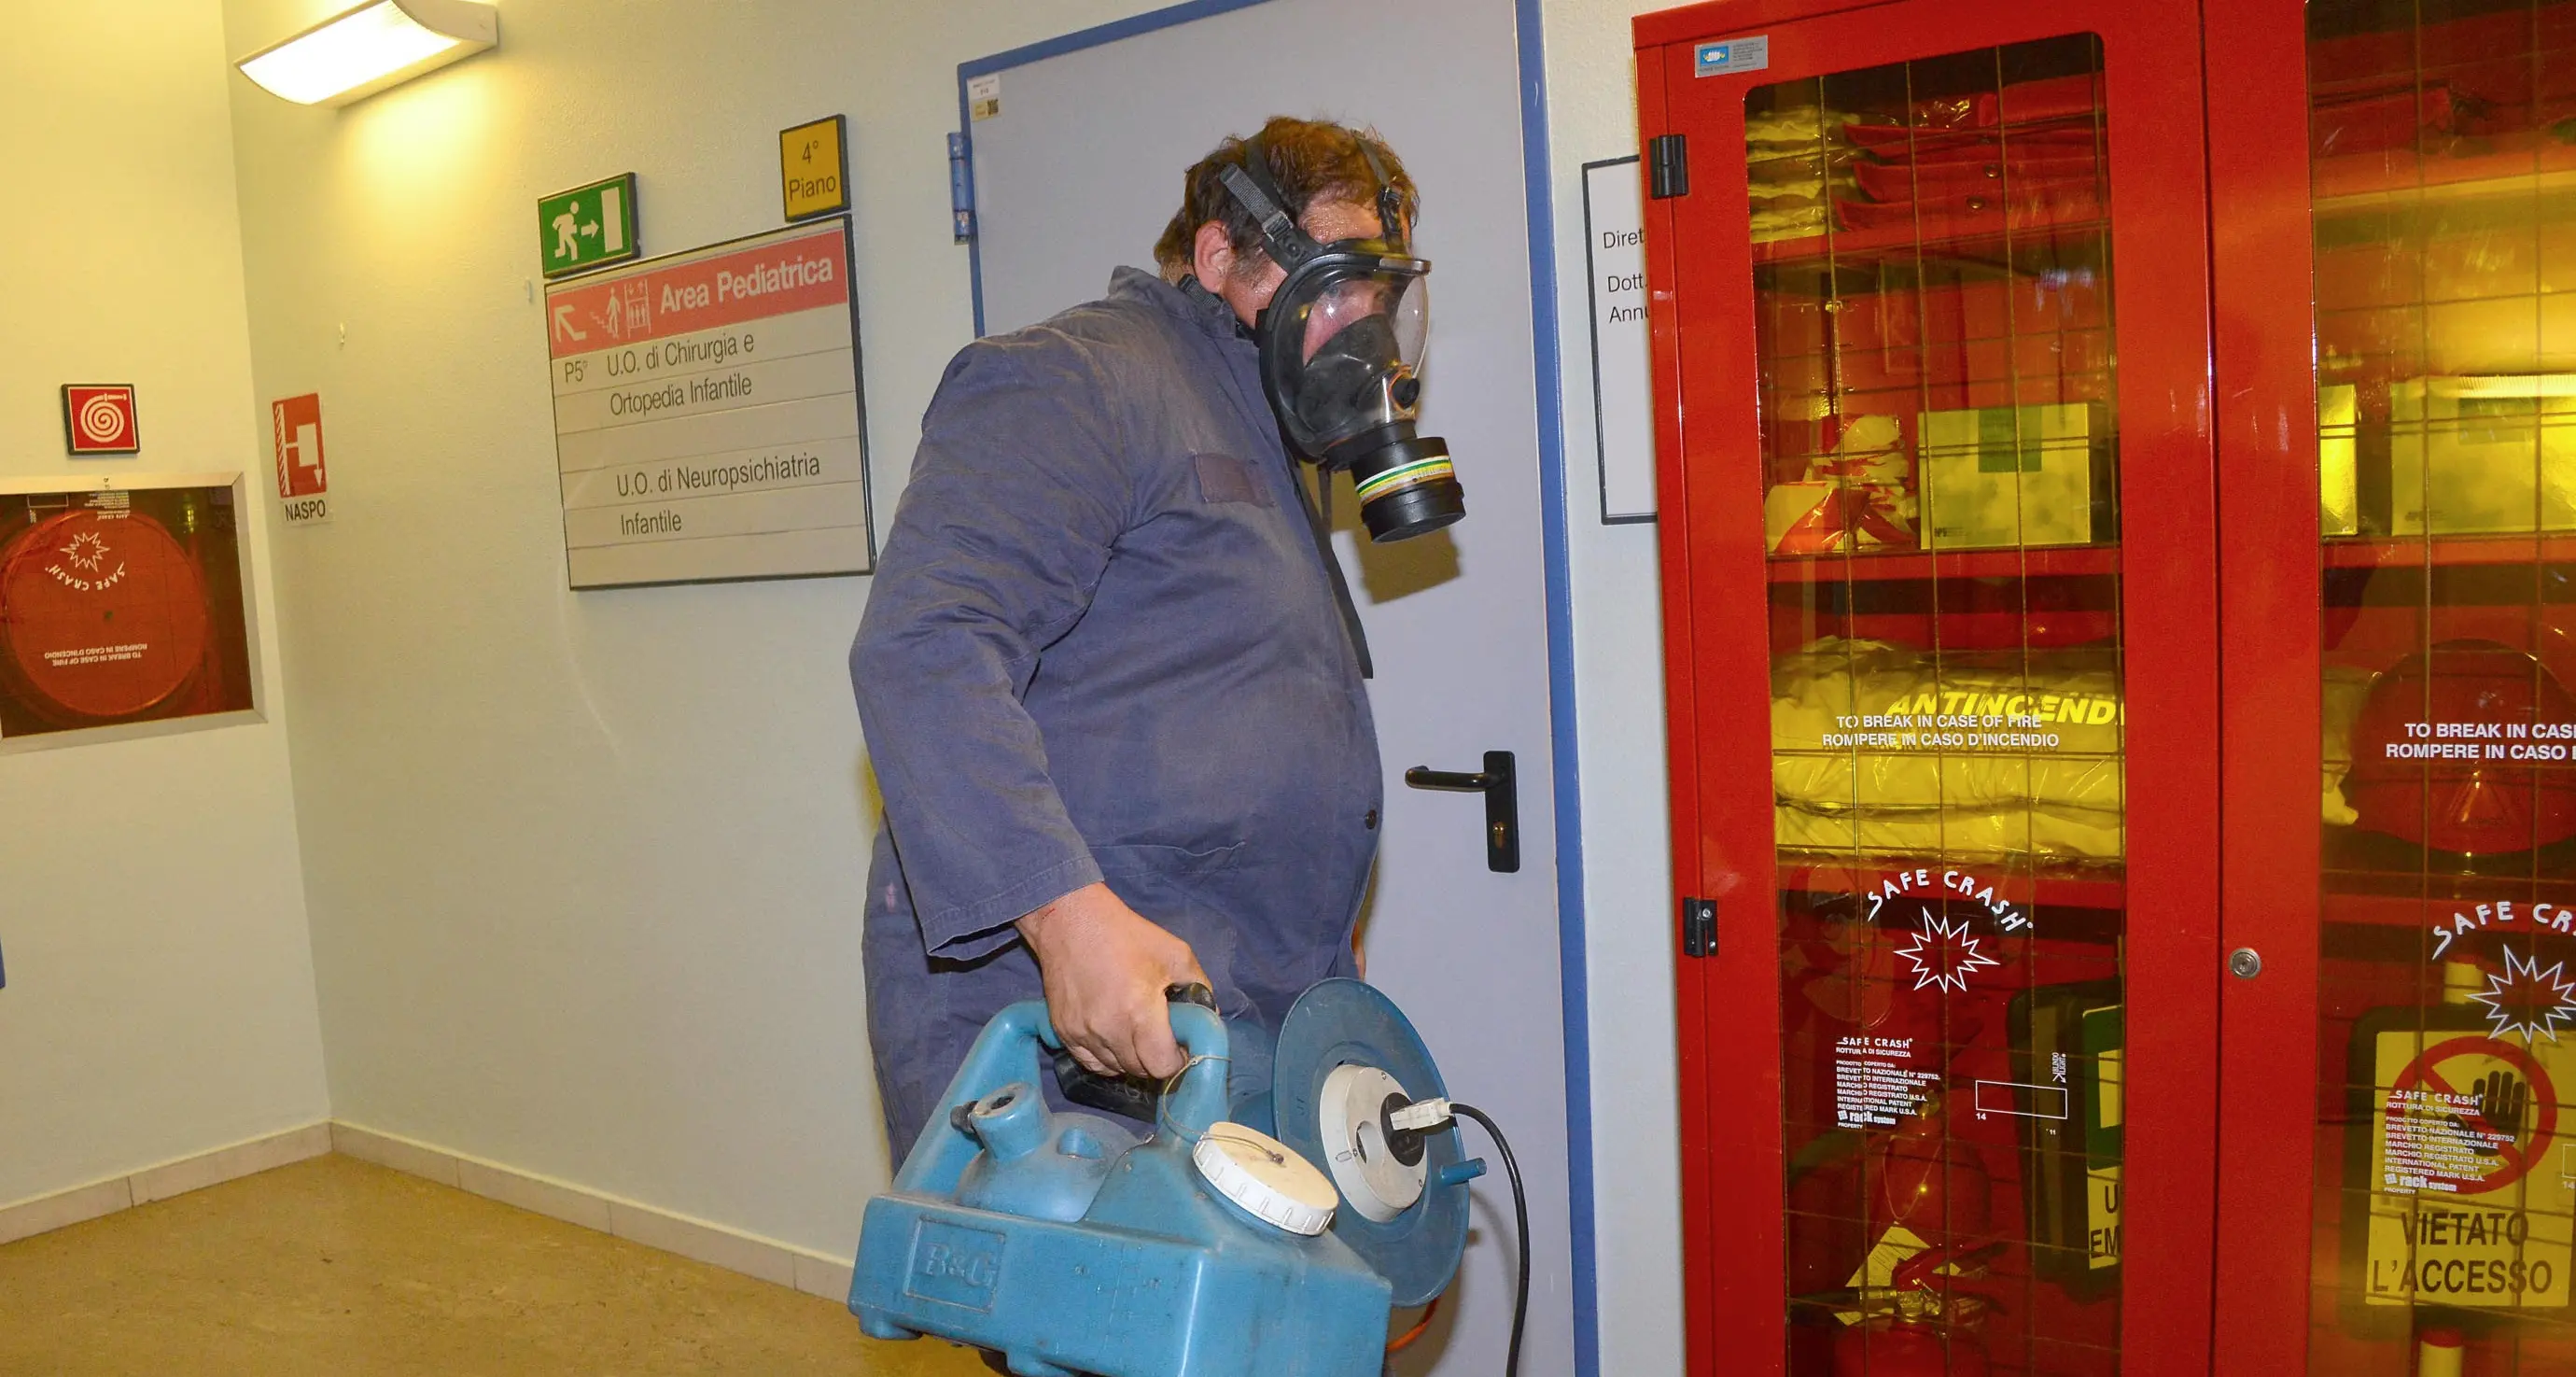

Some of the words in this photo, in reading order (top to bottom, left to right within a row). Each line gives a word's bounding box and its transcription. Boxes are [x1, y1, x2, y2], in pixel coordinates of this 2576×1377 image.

[802, 139, 819, 165] 4°
[788, 175, 836, 203] Piano
[660, 283, 709, 315] Area
[717, 255, 833, 302] Pediatrica
[565, 360, 588, 383] P5°
[607, 350, 640, 376] U.O.
[646, 345, 660, 370] di
[665, 332, 738, 366] Chirurgia
[743, 333, 754, 353] e
[610, 384, 685, 416] Ortopedia
[690, 372, 752, 402] Infantile
[617, 471, 653, 497] U.O.
[658, 468, 672, 492] di
[678, 452, 820, 491] Neuropsichiatria
[285, 499, 327, 522] NASPO
[621, 510, 682, 536] Infantile
[1836, 715, 1859, 728] TO
[1863, 715, 1913, 727] BREAK
[1917, 715, 1932, 727] IN
[1937, 715, 1978, 728] CASE
[1981, 714, 2003, 728] OF
[2008, 715, 2042, 728] FIRE
[2404, 723, 2430, 738] TO
[2436, 724, 2501, 738] BREAK
[2506, 724, 2526, 738] IN
[1822, 733, 1897, 746] ROMPERE
[1901, 733, 1916, 746] IN
[1920, 733, 1964, 746] CASO
[1967, 733, 2059, 747] D'INCENDIO
[2386, 743, 2480, 759] ROMPERE
[2485, 744, 2504, 759] IN
[2510, 745, 2567, 760] CASO
[1868, 869, 1929, 922] SAFE
[2432, 901, 2514, 961] SAFE
[2533, 903, 2576, 935] CR
[1838, 1036, 1869, 1046] SAFE
[1876, 1048, 1911, 1058] SICUREZZA
[1837, 1066, 1871, 1075] BREVETTO
[1872, 1068, 1908, 1077] NAZIONALE
[1869, 1083, 1909, 1092] REGISTRATO
[1872, 1075, 1926, 1087] INTERNAZIONALE
[1837, 1089, 1868, 1097] MARCHIO
[1869, 1090, 1909, 1100] REGISTRATO
[1837, 1096, 1887, 1105] INTERNATIONAL
[2389, 1090, 2427, 1101] SAFE
[1837, 1103, 1878, 1112] REGISTERED
[2387, 1102, 2423, 1111] ROTTURA
[2435, 1106, 2480, 1116] SICUREZZA
[1850, 1111, 1873, 1122] rack
[2386, 1124, 2428, 1133] BREVETTO
[2429, 1127, 2475, 1138] NAZIONALE
[2386, 1132, 2428, 1141] BREVETTO
[2429, 1135, 2499, 1149] INTERNAZIONALE
[2386, 1141, 2422, 1149] MARCHIO
[2424, 1144, 2474, 1154] REGISTRATO
[2385, 1157, 2446, 1169] INTERNATIONAL
[2449, 1163, 2479, 1172] PATENT
[2386, 1149, 2422, 1158] MARCHIO
[2424, 1152, 2474, 1163] REGISTRATO
[2476, 1158, 2499, 1166] U.S.A.
[2385, 1165, 2435, 1175] REGISTERED
[2436, 1170, 2460, 1178] MARK
[2400, 1175, 2427, 1187] rack
[2105, 1184, 2119, 1214] U
[2401, 1211, 2528, 1246] VIETATO
[2091, 1225, 2121, 1258] EM
[2373, 1259, 2552, 1293] L'ACCESSO
